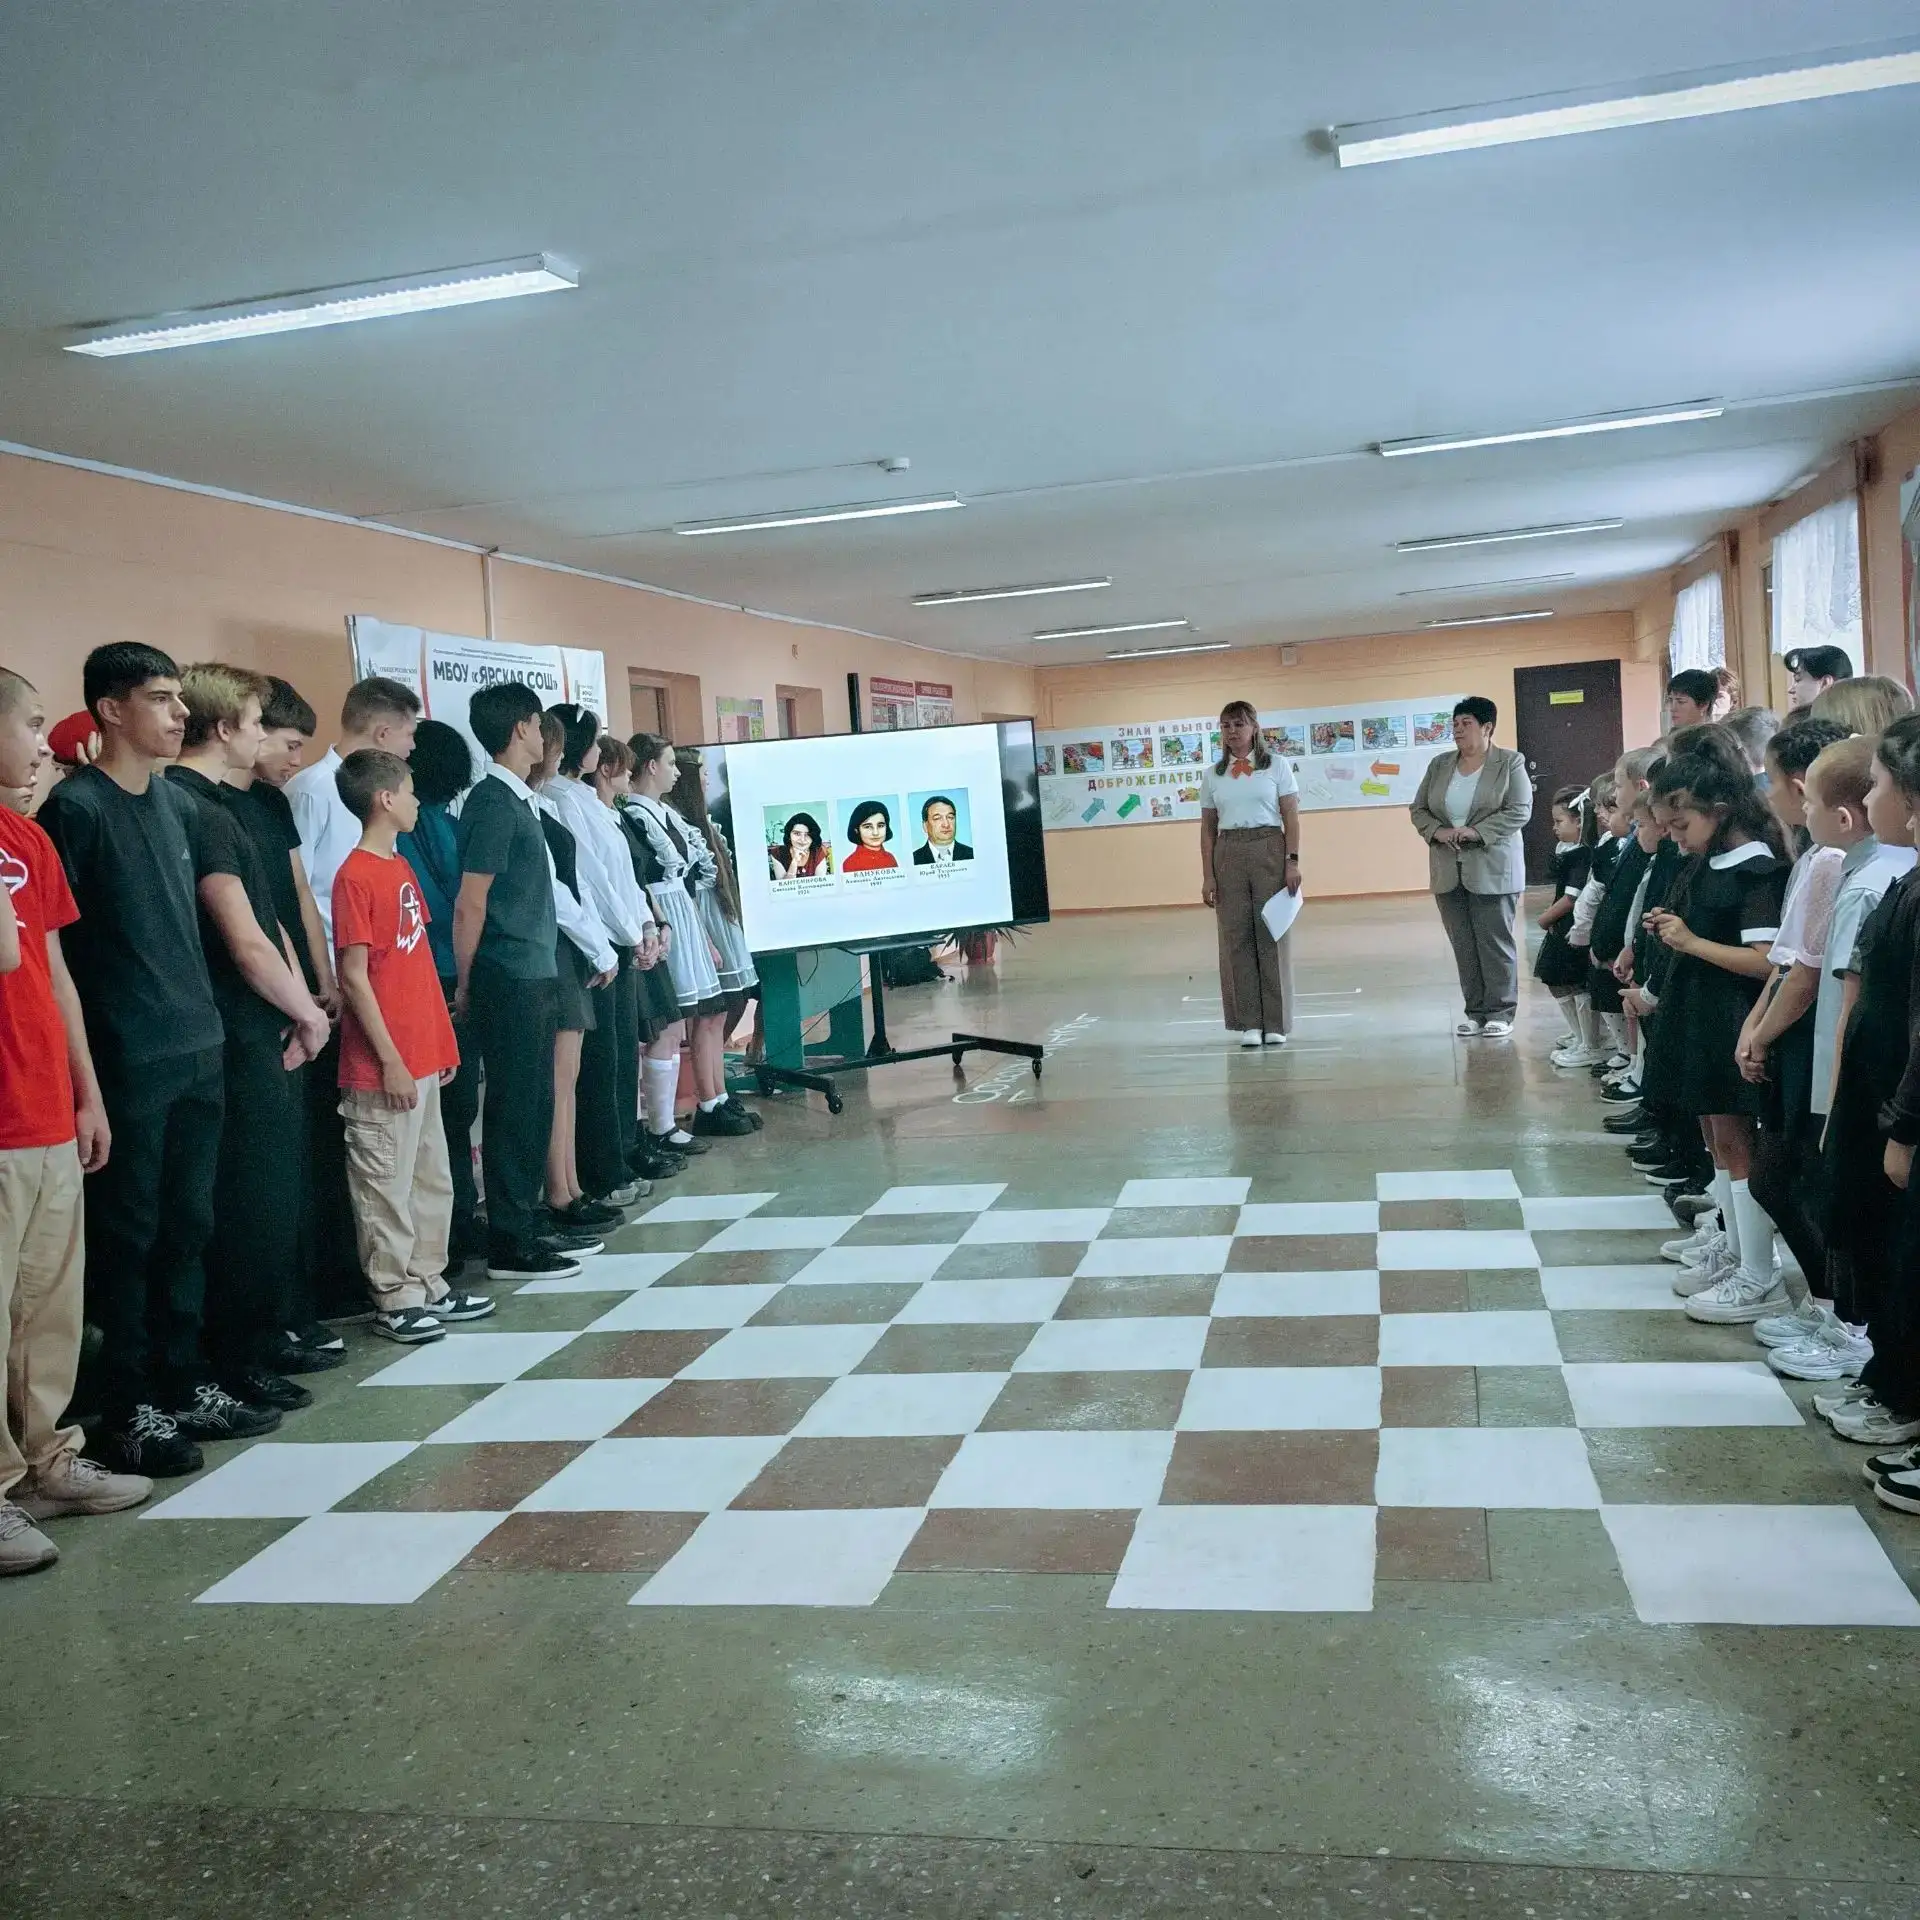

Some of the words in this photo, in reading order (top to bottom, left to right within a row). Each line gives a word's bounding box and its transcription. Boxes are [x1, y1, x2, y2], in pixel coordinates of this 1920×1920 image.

[432, 660, 469, 683] МБОУ
[527, 671, 558, 690] СОШ»
[1118, 725, 1151, 737] ЗНАЙ
[1158, 723, 1166, 735] И
[1172, 721, 1220, 733] ВЫПО
[1088, 770, 1203, 792] ДОБРОЖЕЛАТЕЛ
